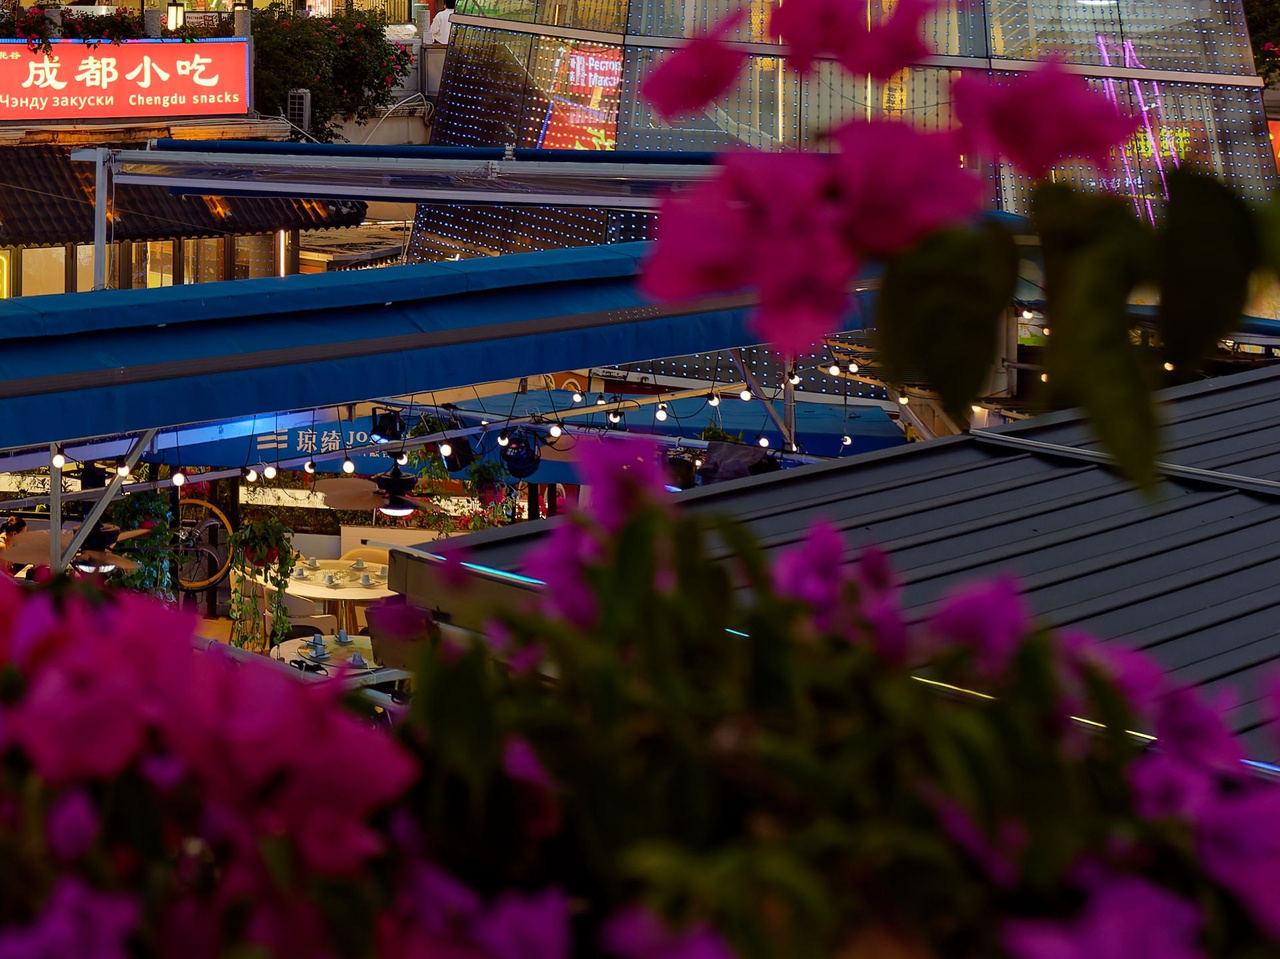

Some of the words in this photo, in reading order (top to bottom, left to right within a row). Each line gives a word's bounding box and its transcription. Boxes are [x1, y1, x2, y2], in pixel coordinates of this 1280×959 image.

[21, 54, 219, 90] 成都小吃
[0, 94, 48, 110] Чэнду
[52, 95, 114, 109] закуски
[128, 93, 186, 108] Chengdu
[192, 91, 239, 105] snacks
[346, 430, 373, 446] JO
